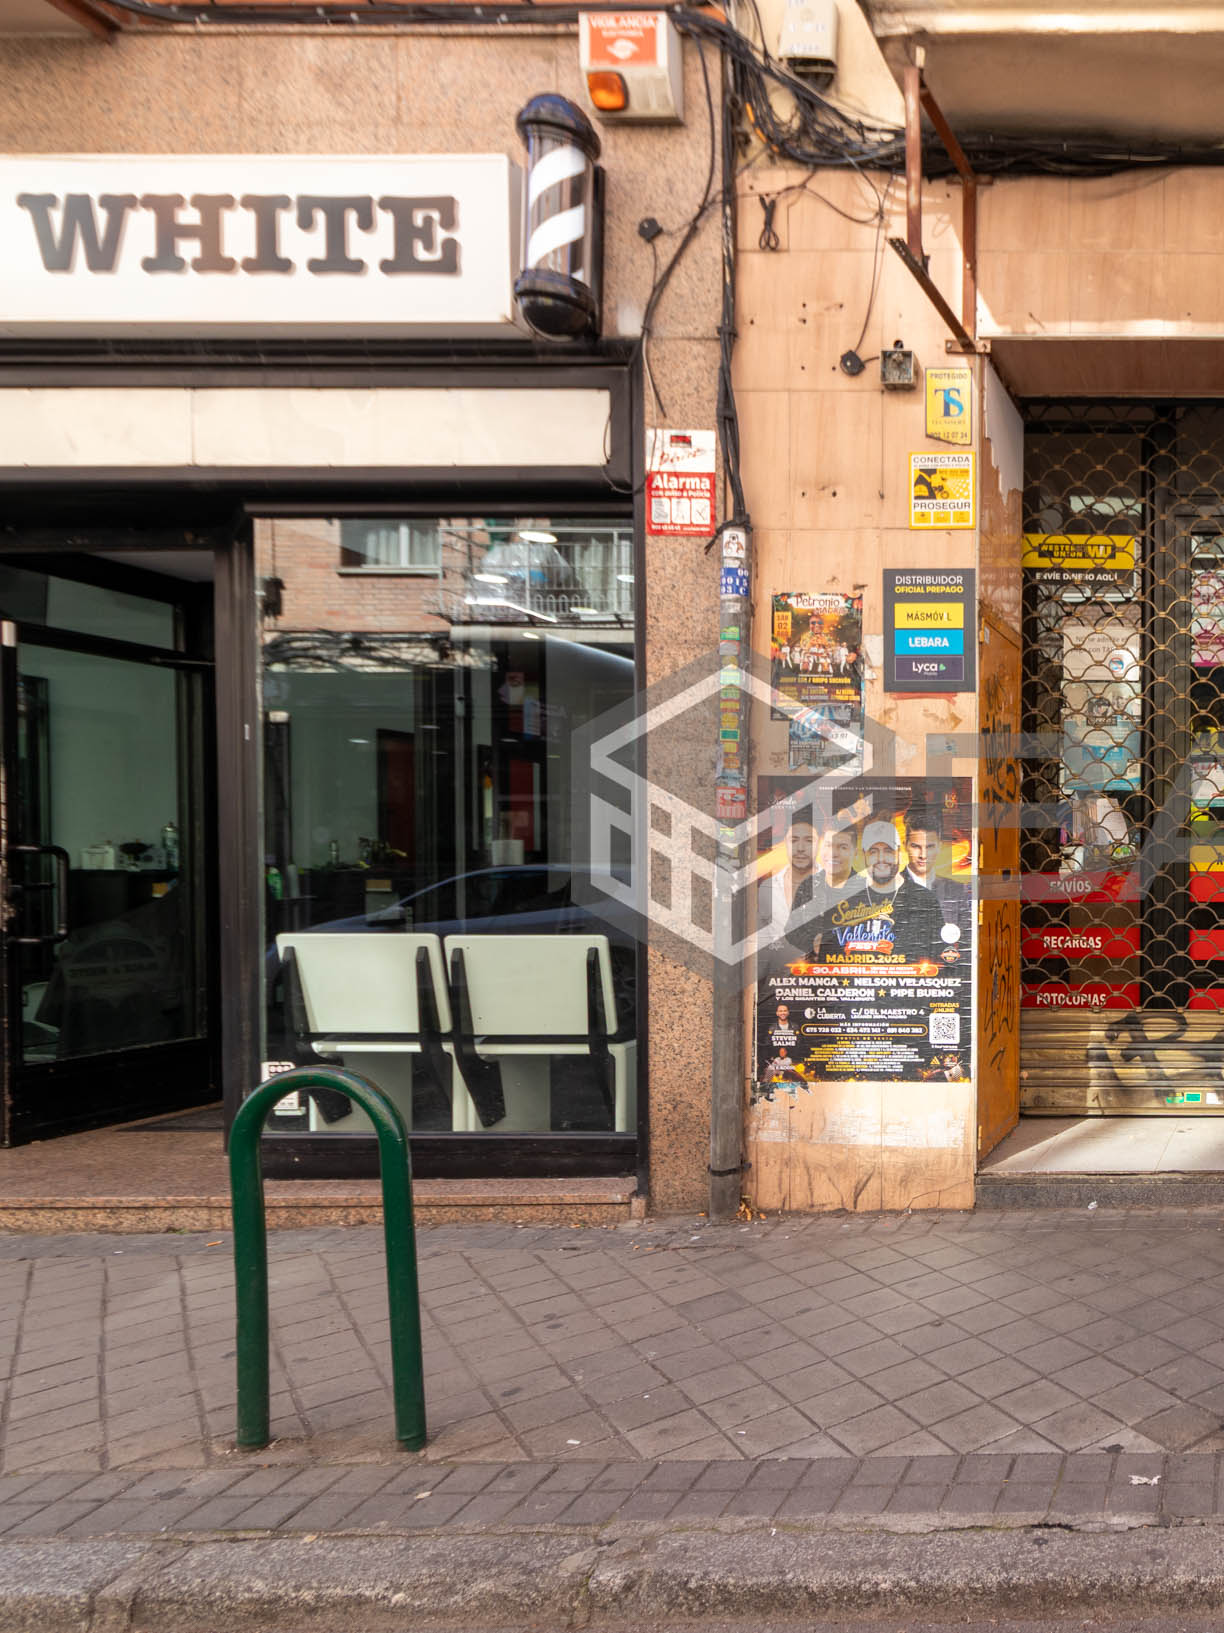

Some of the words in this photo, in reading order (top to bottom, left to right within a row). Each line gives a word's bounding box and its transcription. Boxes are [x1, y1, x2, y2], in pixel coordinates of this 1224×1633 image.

[17, 193, 463, 276] WHITE
[929, 372, 968, 380] PROTEGIDO
[913, 456, 970, 464] CONECTADA
[651, 472, 711, 490] Alarma
[913, 502, 971, 511] PROSEGUR
[1041, 544, 1083, 552] WESTE
[895, 575, 964, 585] DISTRIBUIDOR
[1062, 572, 1095, 581] DNEO
[894, 585, 925, 594] OFICIAL
[926, 585, 964, 594] PREPAGO
[908, 637, 950, 648] LEBARA
[912, 661, 938, 673] Lyca
[1050, 879, 1092, 893] ENVÍOS
[1043, 935, 1102, 949] RECARGAS
[769, 977, 797, 987] ALEX
[798, 977, 839, 987] MANGA
[854, 977, 897, 987] NELSON
[897, 977, 962, 988] VELASQUEZ
[775, 988, 815, 998] DANIEL
[816, 988, 875, 998] CALDERON
[890, 988, 915, 998] PIPE
[916, 988, 955, 998] BUENO
[1036, 992, 1107, 1006] FOTOCOPIAS
[863, 1008, 880, 1016] DEL
[881, 1008, 918, 1016] MAESTRO
